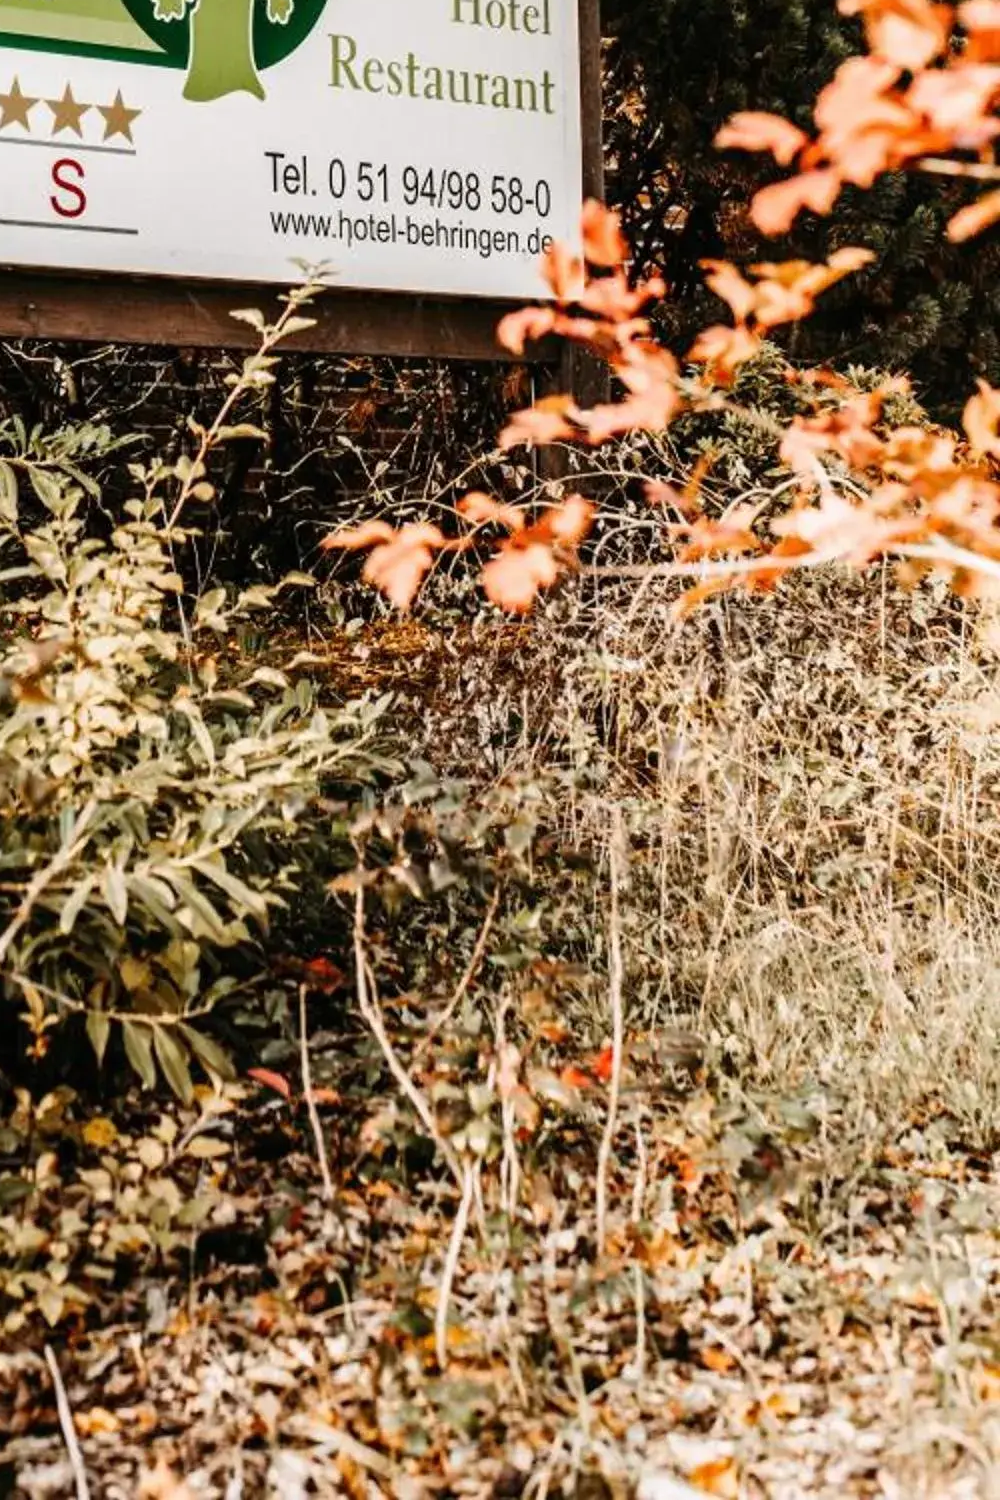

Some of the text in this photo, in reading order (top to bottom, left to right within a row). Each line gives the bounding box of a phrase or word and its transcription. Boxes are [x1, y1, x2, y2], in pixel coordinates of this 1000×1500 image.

[328, 33, 555, 114] Restaurant
[50, 158, 88, 219] S
[264, 151, 552, 217] Tel. 0 51 94/98 58-0
[270, 209, 553, 258] www.hotel-behringen.de
